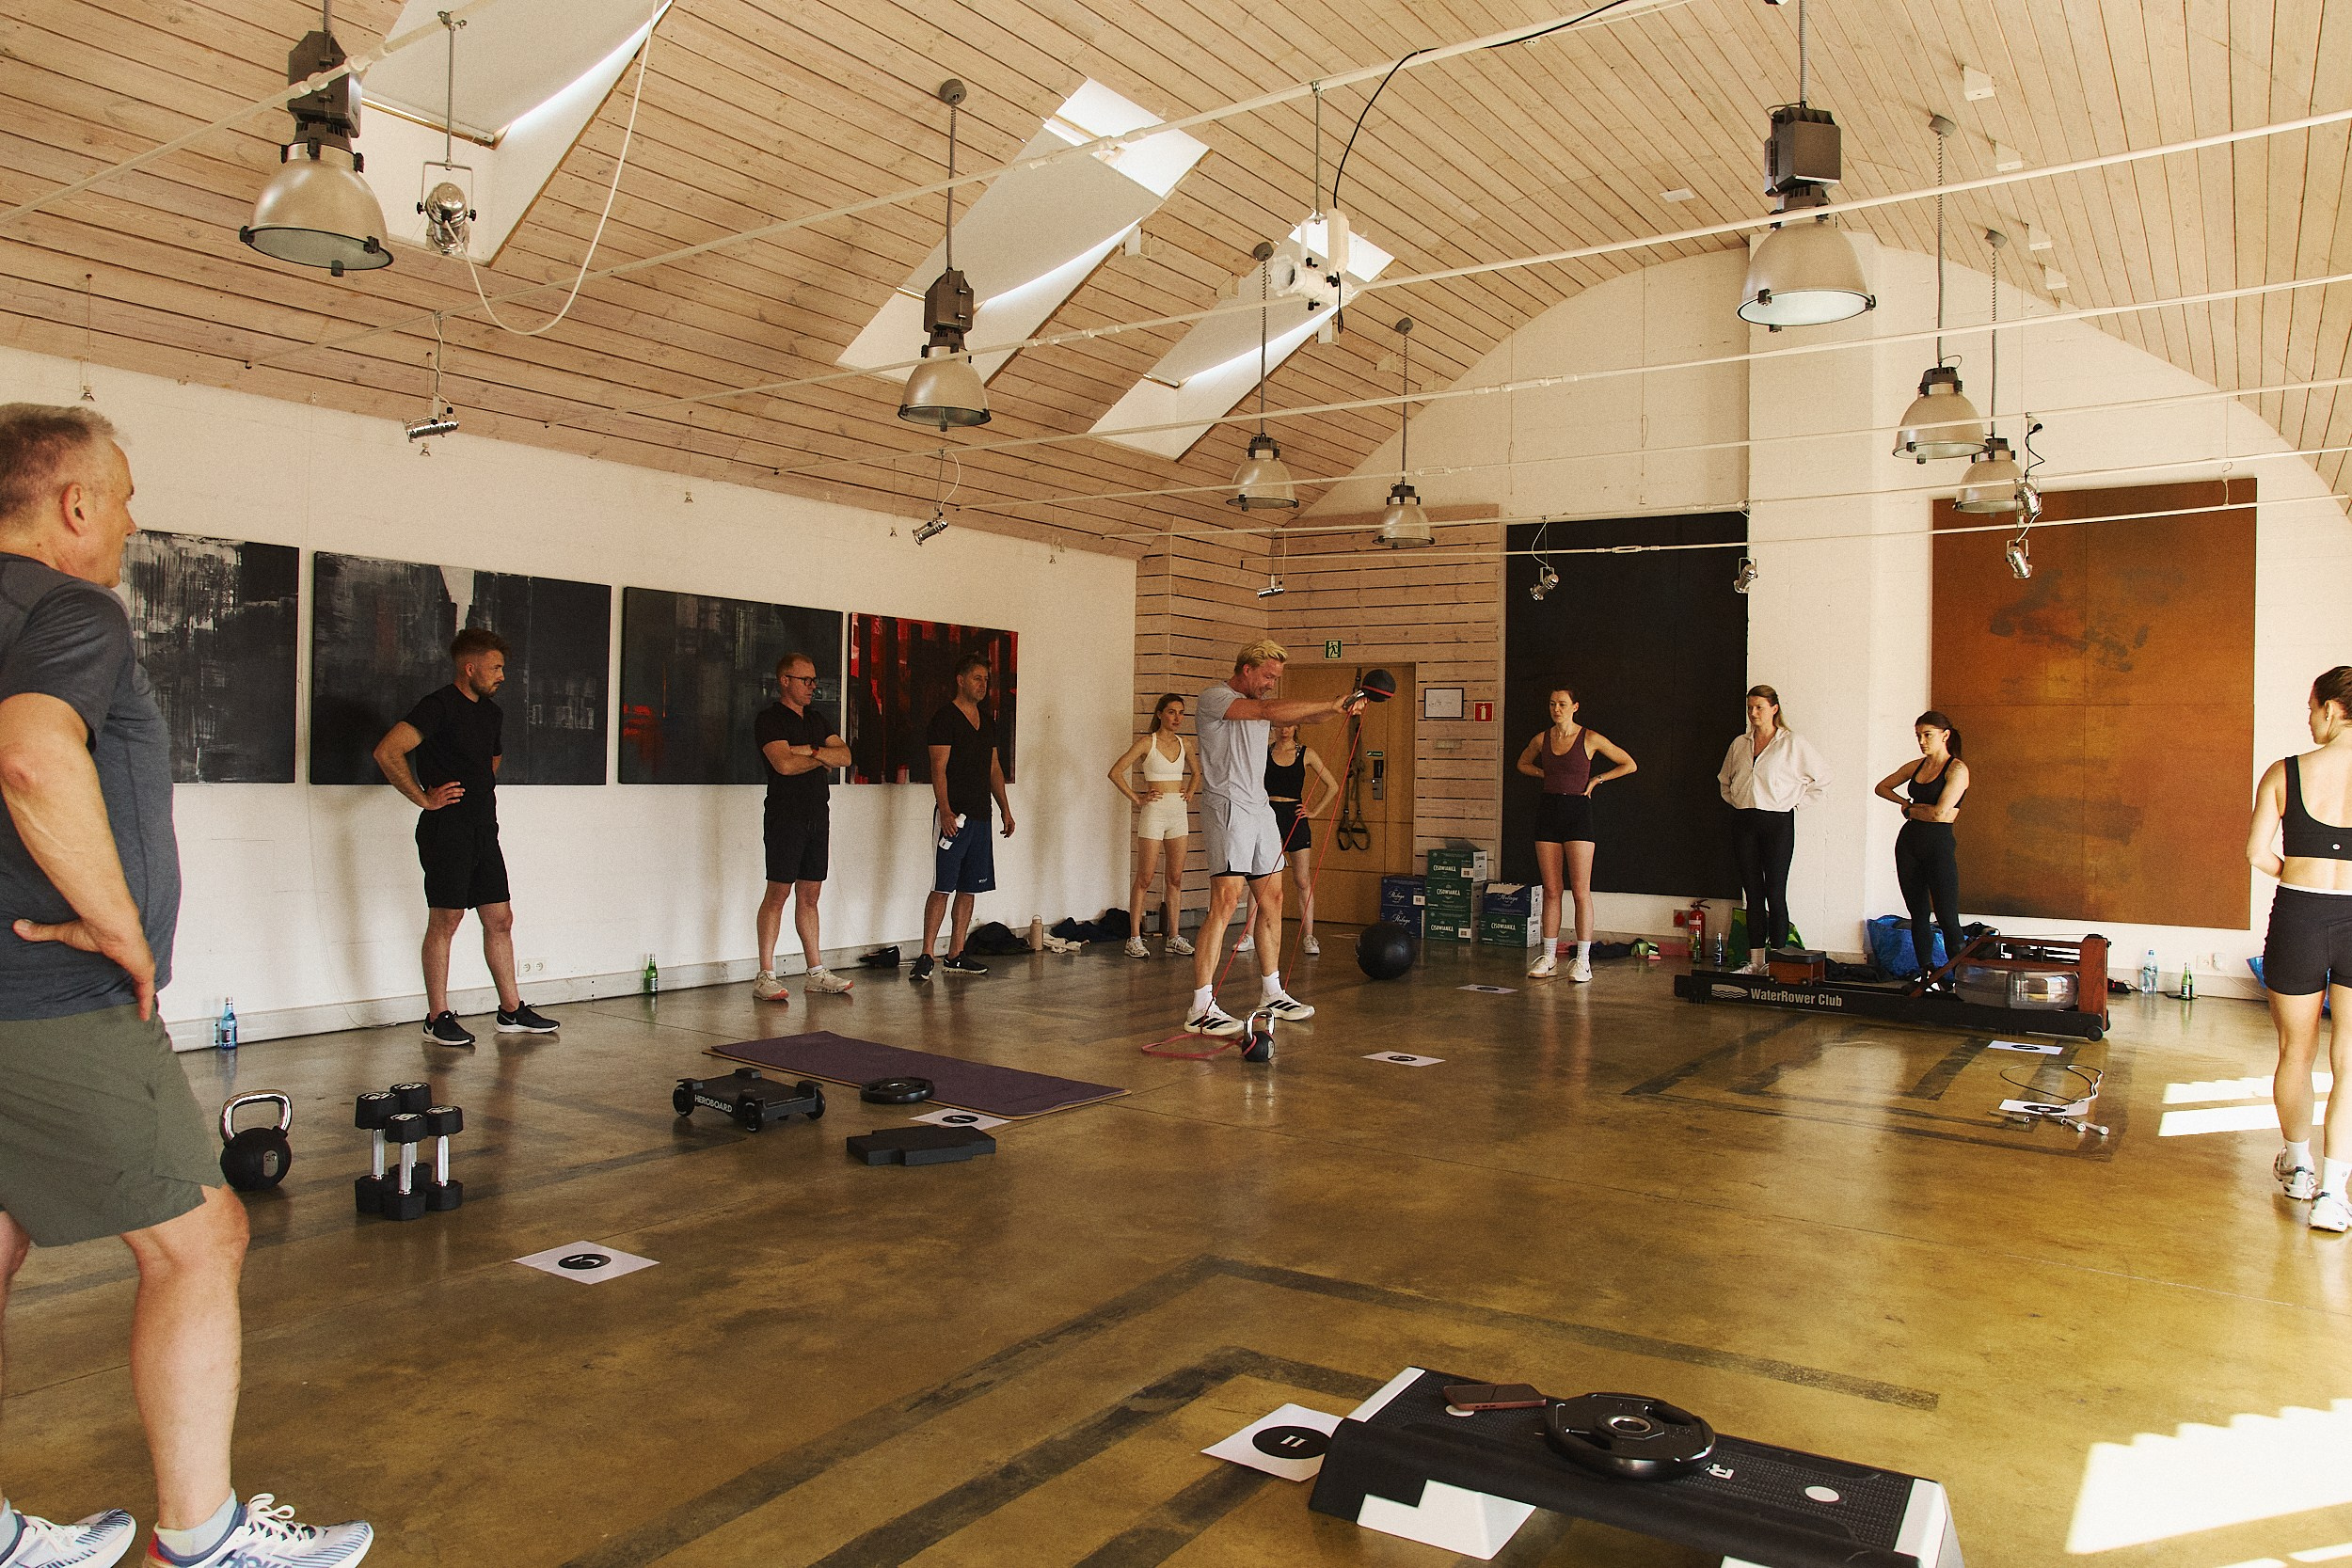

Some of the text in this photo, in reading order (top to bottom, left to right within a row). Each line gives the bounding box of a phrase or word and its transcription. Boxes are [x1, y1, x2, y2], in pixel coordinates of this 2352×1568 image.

[1436, 888, 1460, 896] CISOWIANKA
[1430, 924, 1454, 932] CISOWIANKA
[1490, 922, 1516, 931] CISOWIANKA
[1750, 988, 1843, 1007] WaterRower Club
[694, 1094, 733, 1113] HEROBOARD
